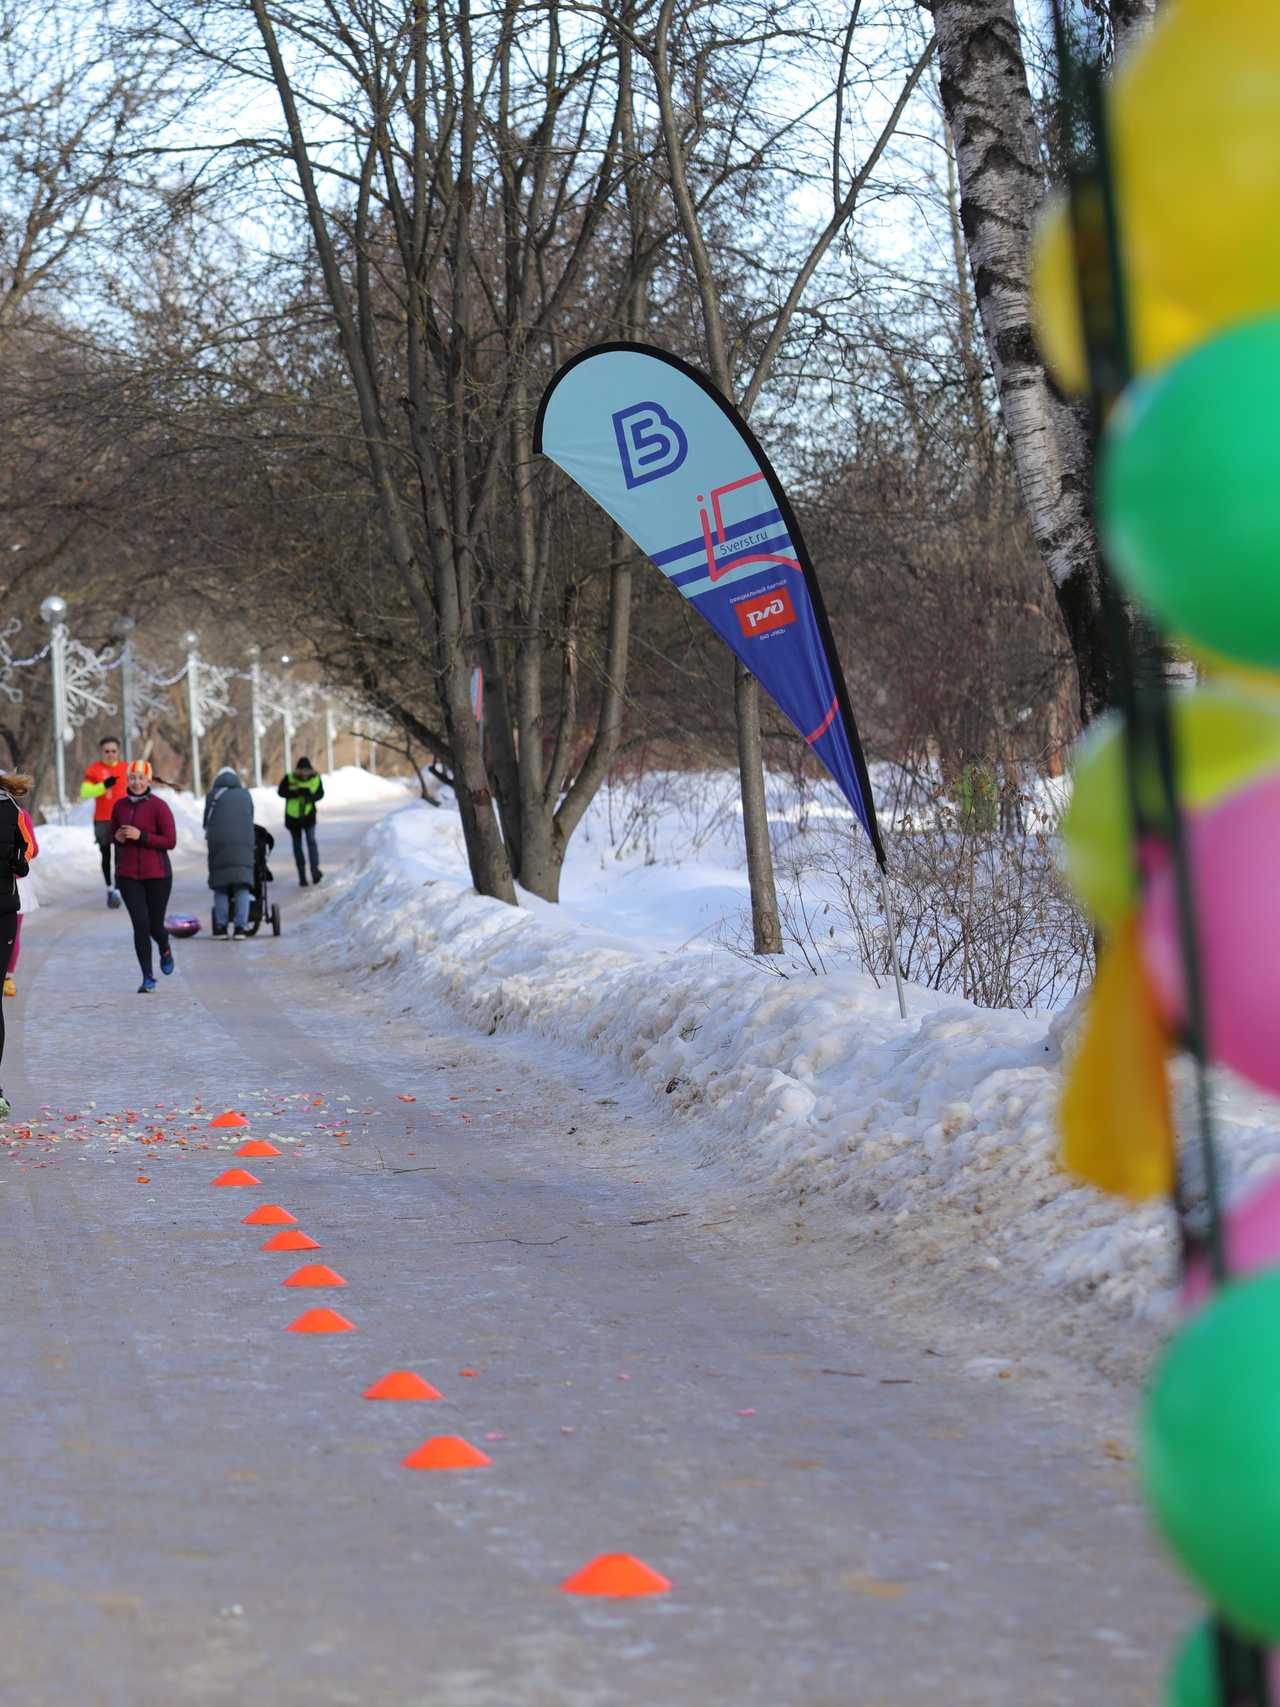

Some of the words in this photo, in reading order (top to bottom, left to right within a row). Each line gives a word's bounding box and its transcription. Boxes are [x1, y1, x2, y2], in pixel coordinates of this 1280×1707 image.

[719, 530, 769, 556] 5verst.ru
[729, 586, 767, 604] ОФИЦИАЛЬНЫЙ
[766, 579, 788, 591] ПАРТНЕР
[759, 633, 770, 641] ОАО
